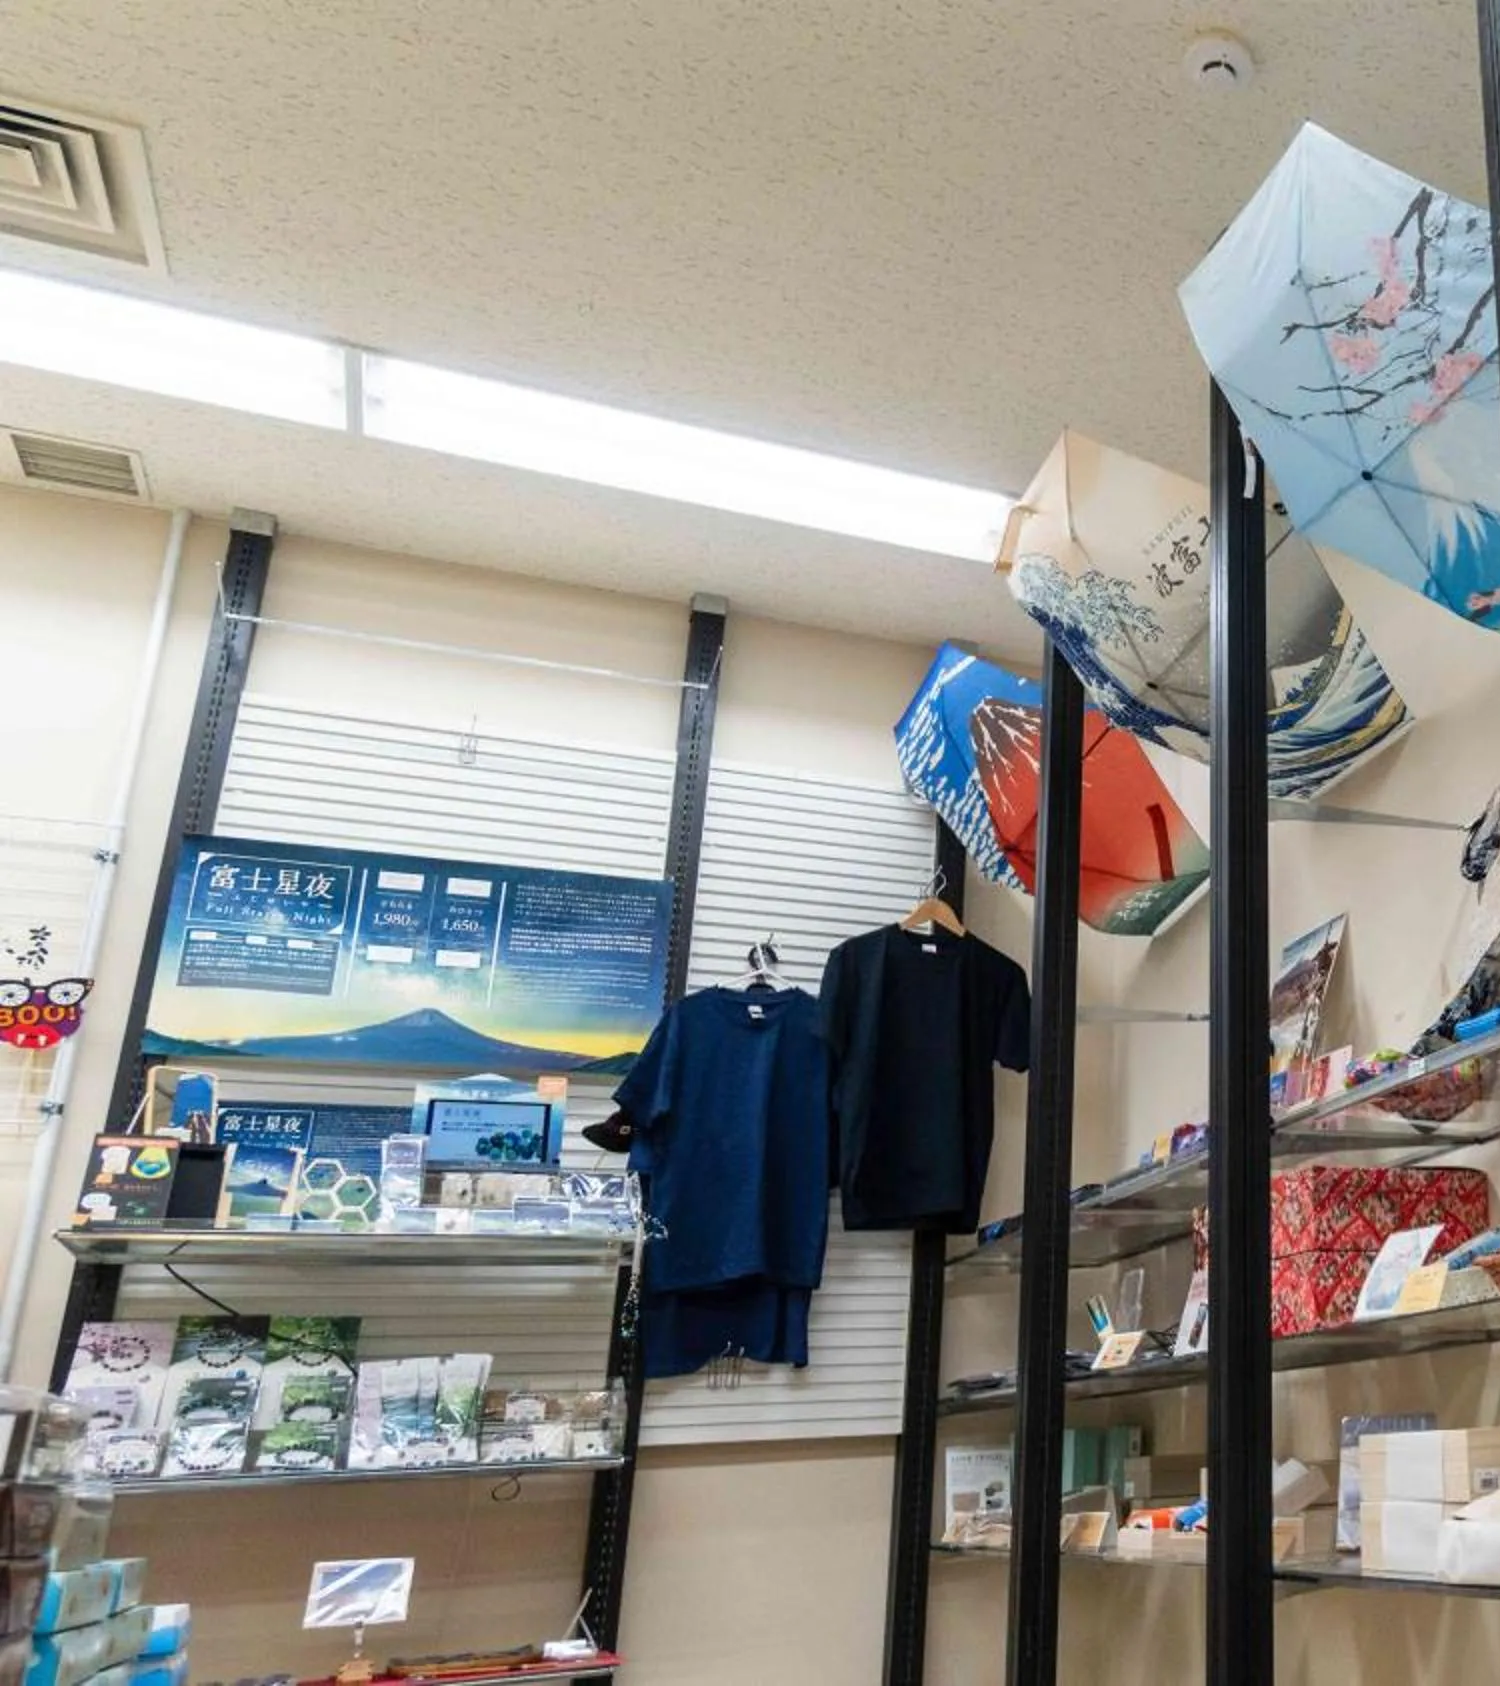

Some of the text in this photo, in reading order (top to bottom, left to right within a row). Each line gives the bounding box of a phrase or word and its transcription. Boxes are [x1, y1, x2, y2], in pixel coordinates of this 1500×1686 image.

[209, 863, 337, 900] 富士星夜
[223, 1115, 304, 1133] 富士星夜
